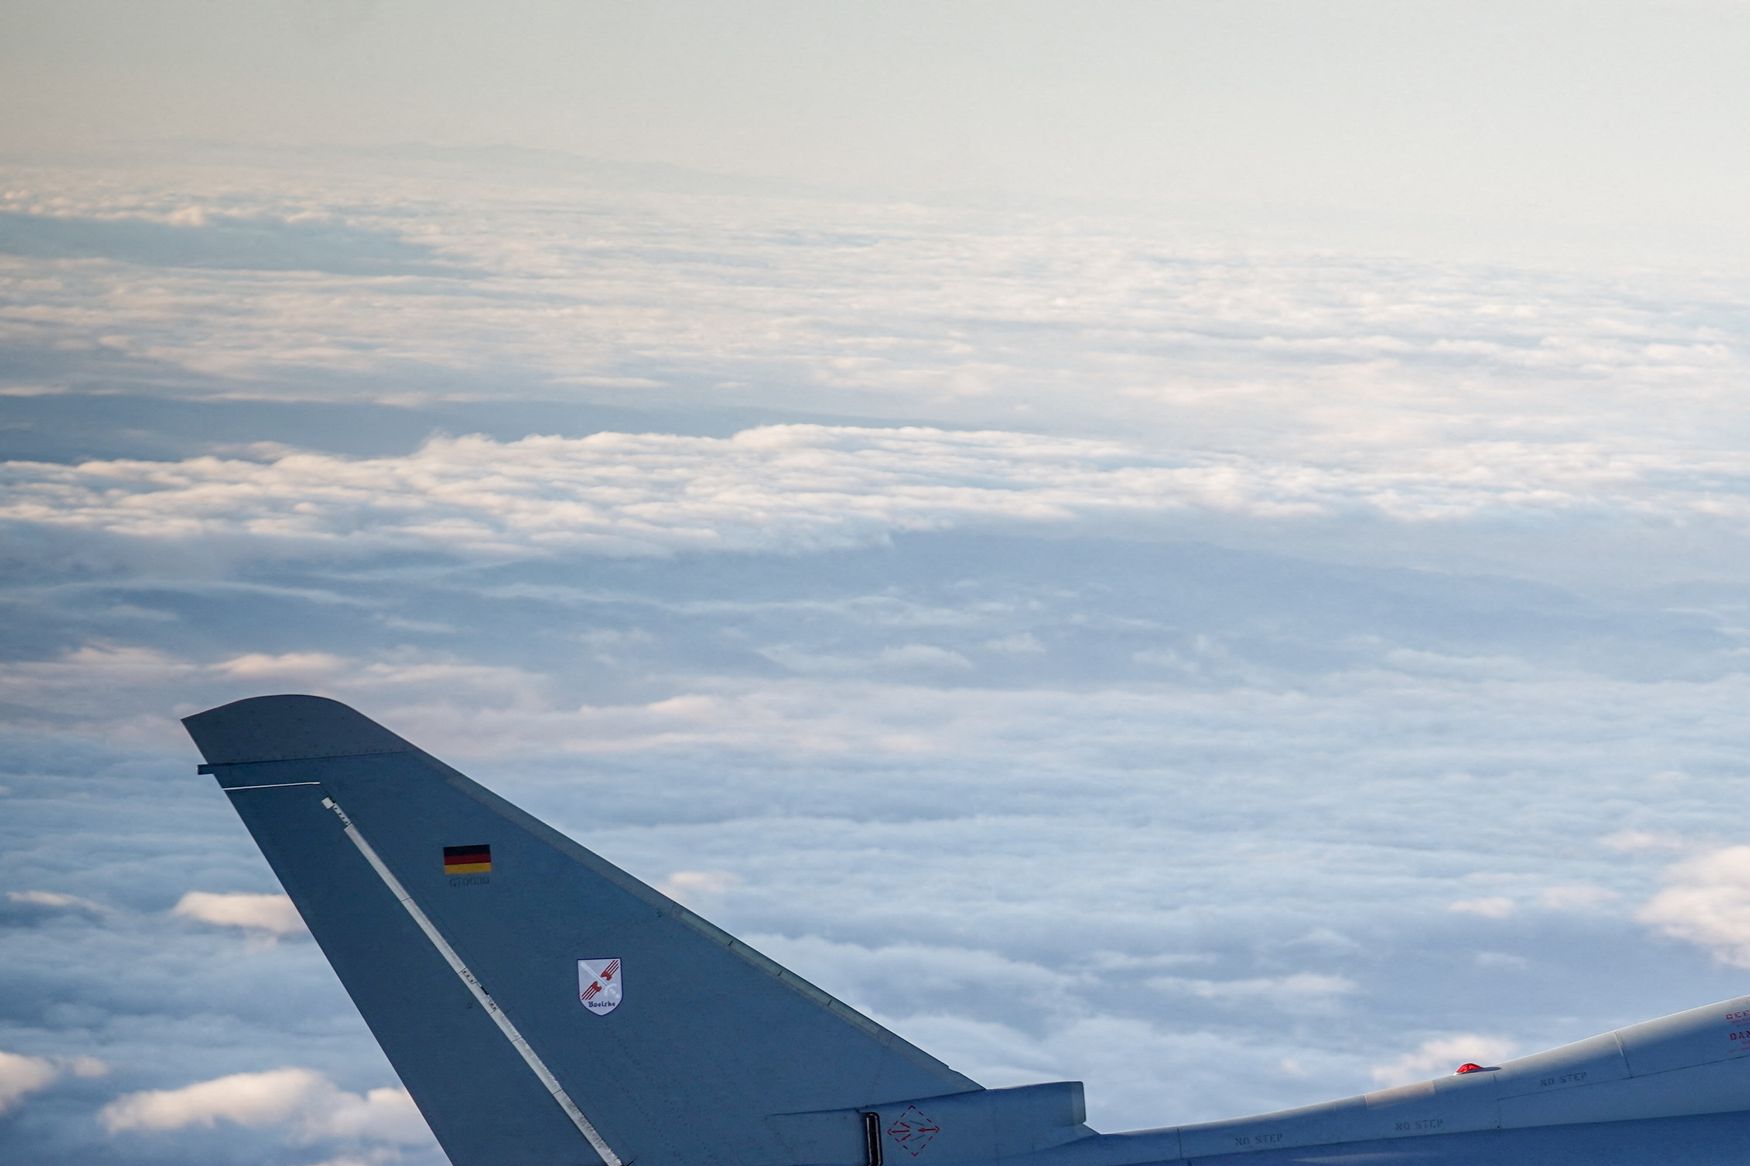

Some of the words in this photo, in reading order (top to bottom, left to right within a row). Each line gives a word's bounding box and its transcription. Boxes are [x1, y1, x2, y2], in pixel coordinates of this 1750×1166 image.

[1540, 1076, 1555, 1086] NO
[1559, 1071, 1587, 1083] STEP
[1395, 1121, 1410, 1131] NO
[1415, 1118, 1444, 1129] STEP
[1235, 1136, 1250, 1145] NO
[1254, 1132, 1283, 1143] STEP
